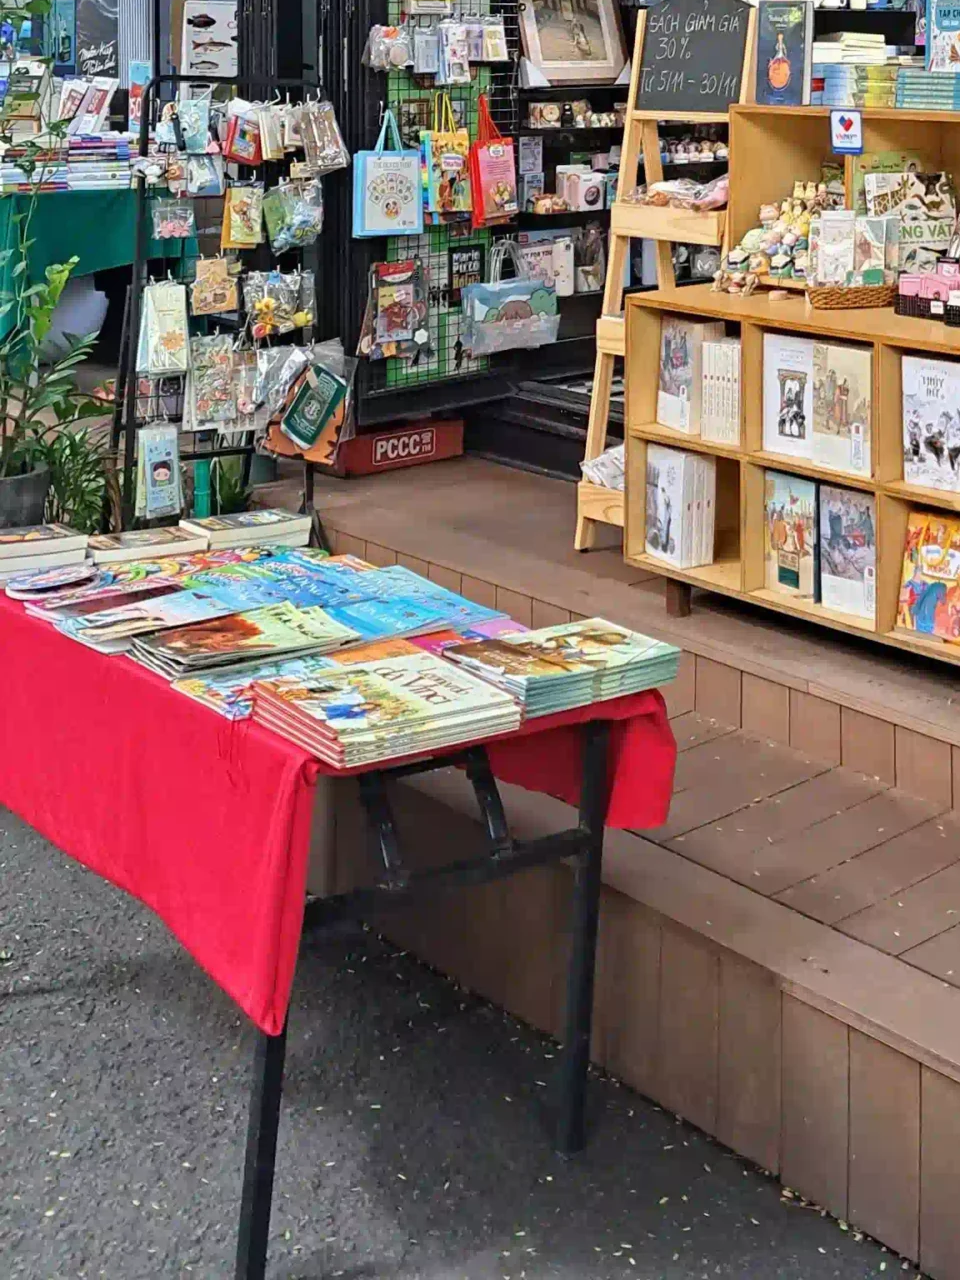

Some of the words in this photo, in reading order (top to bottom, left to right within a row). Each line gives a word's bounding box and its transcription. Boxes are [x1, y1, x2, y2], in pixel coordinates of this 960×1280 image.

[650, 4, 680, 34] SÁCH
[719, 7, 744, 33] GIÁ
[658, 70, 684, 93] 5/11
[700, 71, 738, 98] 30/11
[900, 225, 924, 239] NG
[376, 434, 420, 461] PCCC
[401, 672, 451, 706] Vinci
